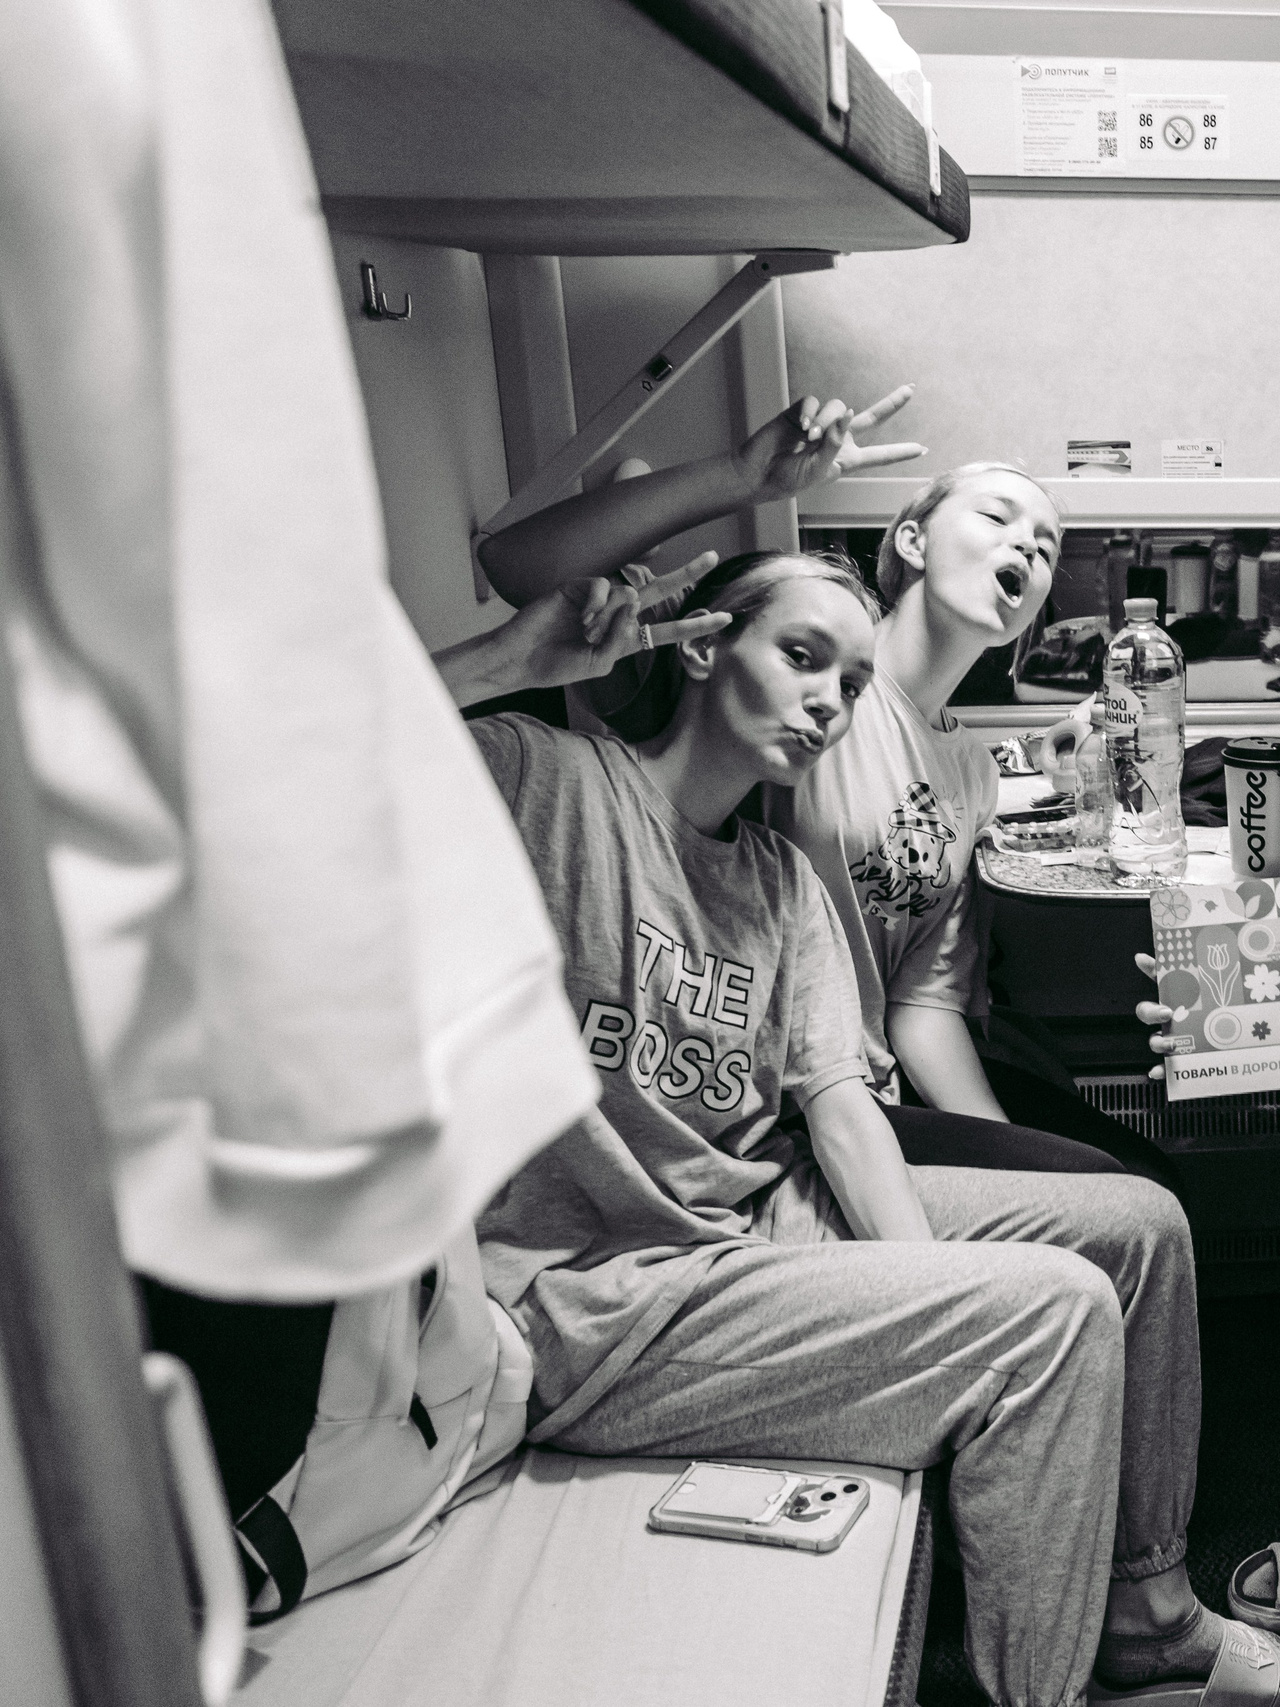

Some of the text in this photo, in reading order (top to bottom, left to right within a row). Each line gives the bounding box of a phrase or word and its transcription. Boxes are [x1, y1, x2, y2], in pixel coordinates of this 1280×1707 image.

[1045, 68, 1089, 77] ПОПУТЧИК
[1139, 113, 1153, 127] 86
[1203, 114, 1217, 128] 88
[1140, 136, 1154, 149] 85
[1204, 136, 1217, 150] 87
[1104, 698, 1127, 711] ТОЙ
[1105, 710, 1138, 724] ЧНИК
[1240, 771, 1267, 872] coffee
[636, 918, 754, 1030] THE
[580, 999, 752, 1113] BOSS
[1173, 1065, 1228, 1081] ТОВАРЫ
[1231, 1065, 1239, 1075] В
